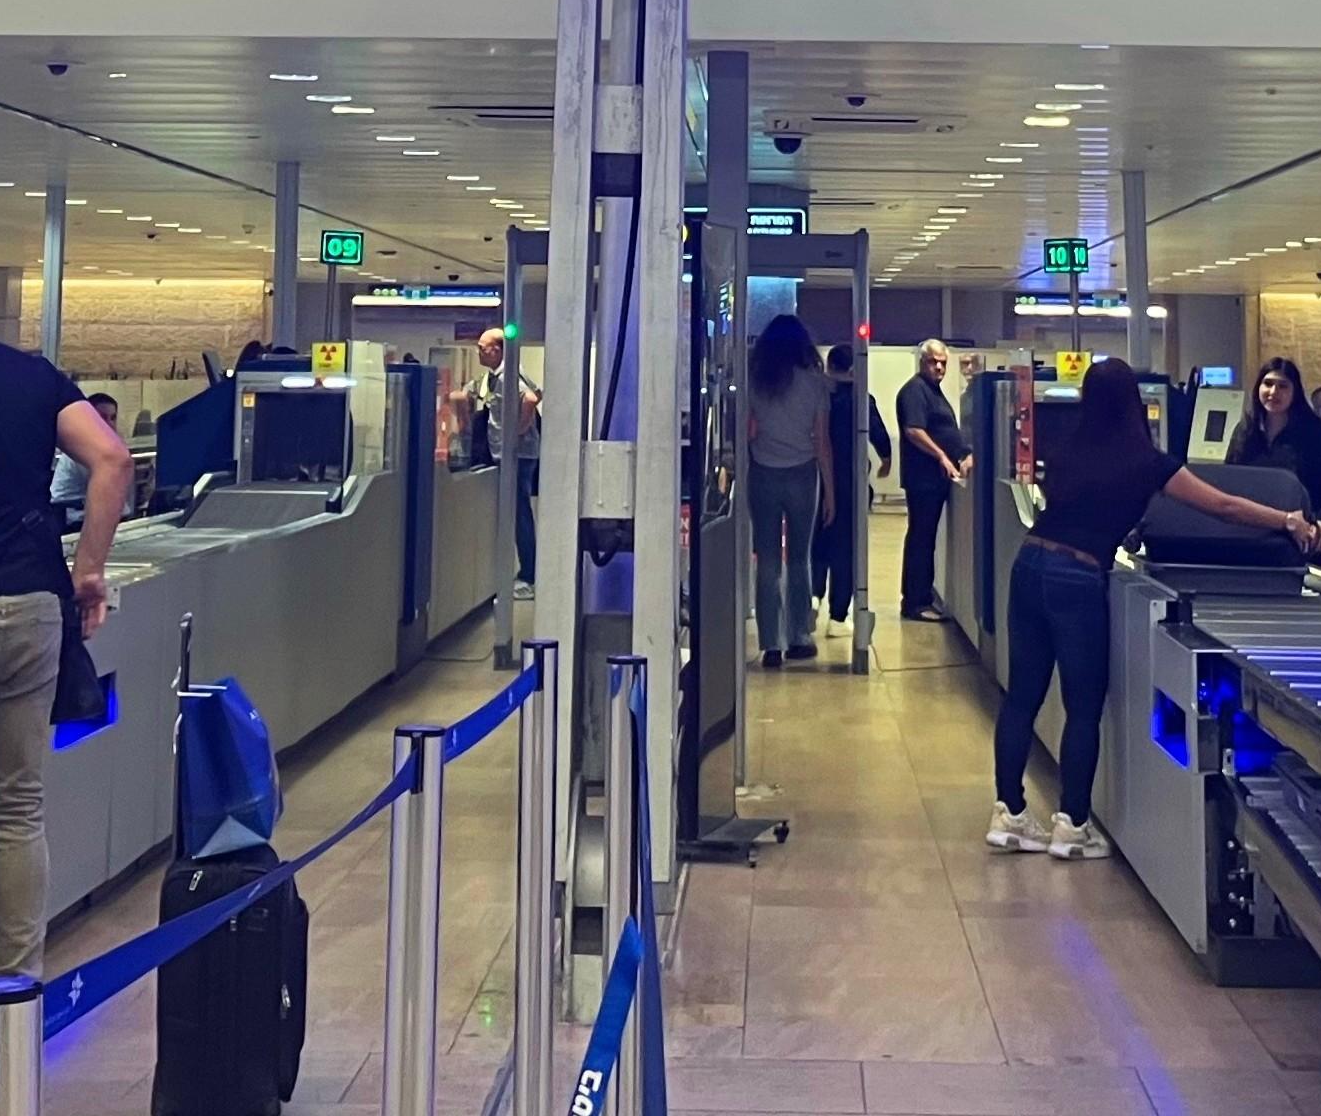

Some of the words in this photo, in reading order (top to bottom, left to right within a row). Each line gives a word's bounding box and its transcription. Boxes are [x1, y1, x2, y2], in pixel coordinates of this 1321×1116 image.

[328, 238, 357, 257] 09
[1048, 246, 1067, 265] 10
[1073, 247, 1086, 265] 10
[571, 1069, 604, 1116] ביט
